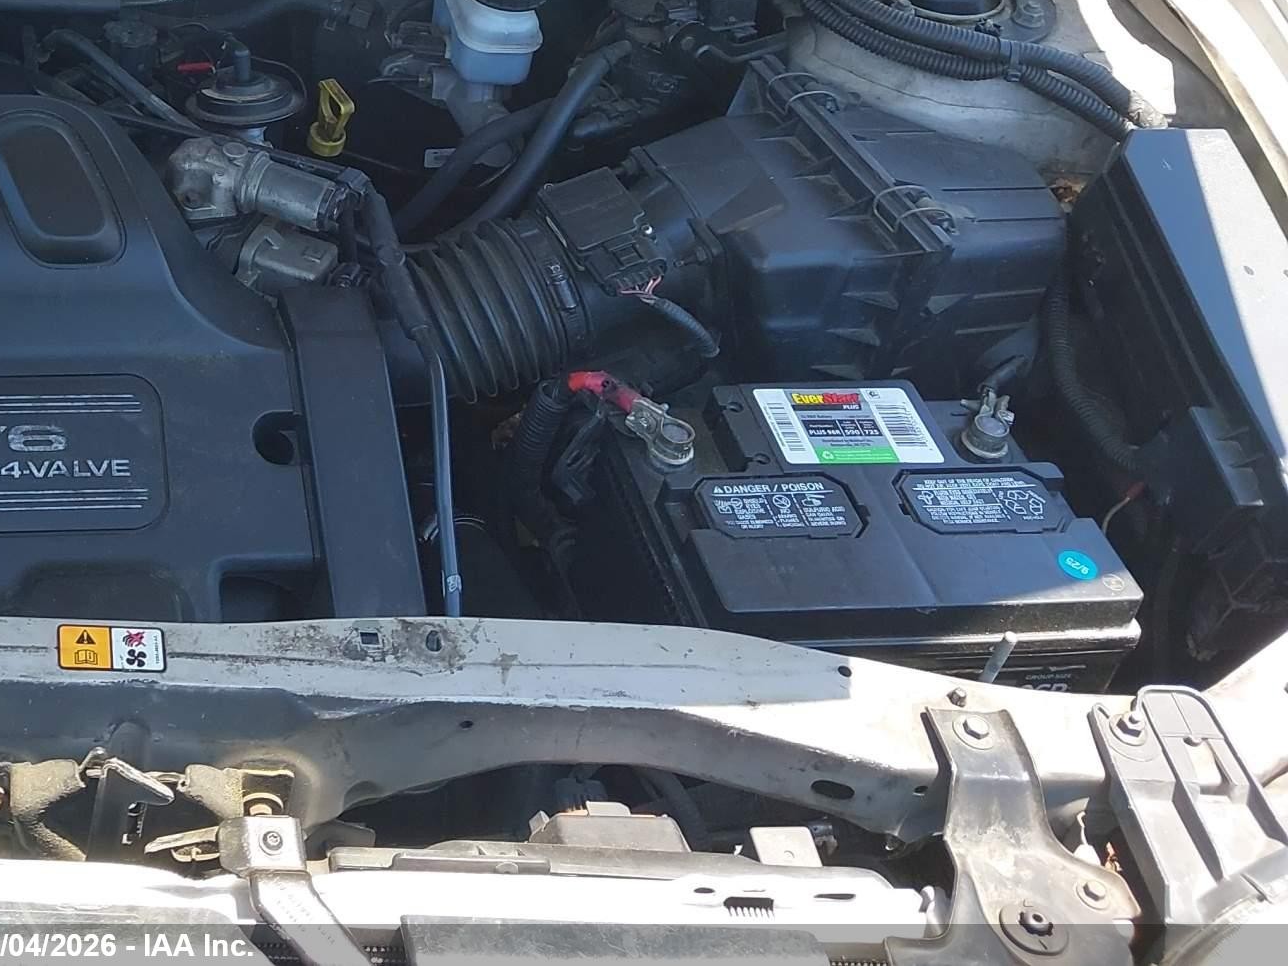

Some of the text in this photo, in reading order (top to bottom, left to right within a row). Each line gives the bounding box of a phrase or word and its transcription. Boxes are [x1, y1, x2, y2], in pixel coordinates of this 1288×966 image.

[792, 393, 859, 404] EverStart
[724, 484, 771, 494] DANGER
[781, 482, 824, 492] POISON
[1065, 556, 1090, 575] 9/25
